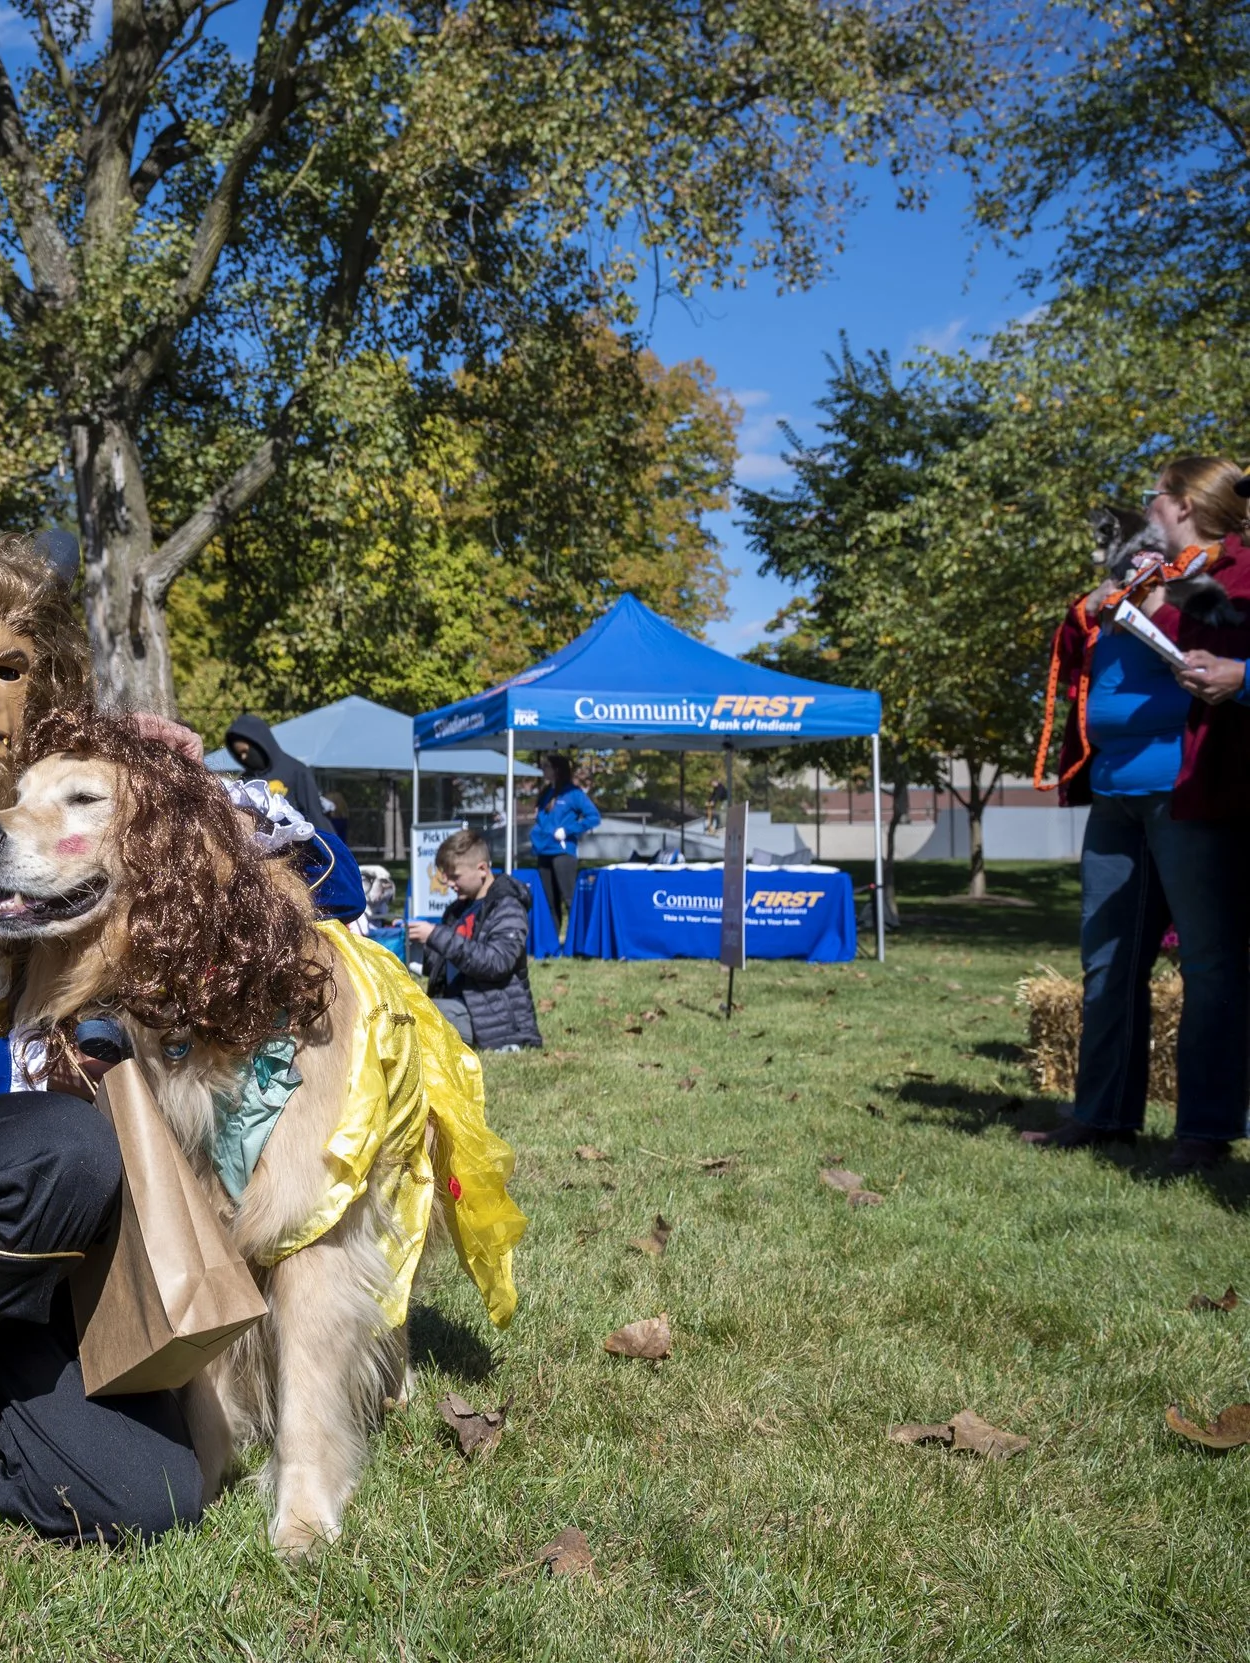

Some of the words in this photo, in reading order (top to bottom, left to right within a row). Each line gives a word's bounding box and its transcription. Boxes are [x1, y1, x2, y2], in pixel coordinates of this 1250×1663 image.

[574, 697, 710, 728] Community
[712, 695, 815, 717] FIRST
[513, 713, 539, 726] FDIC
[710, 718, 740, 731] Bank
[741, 719, 756, 731] of
[756, 719, 802, 732] Indiana
[750, 891, 825, 908] FIRST
